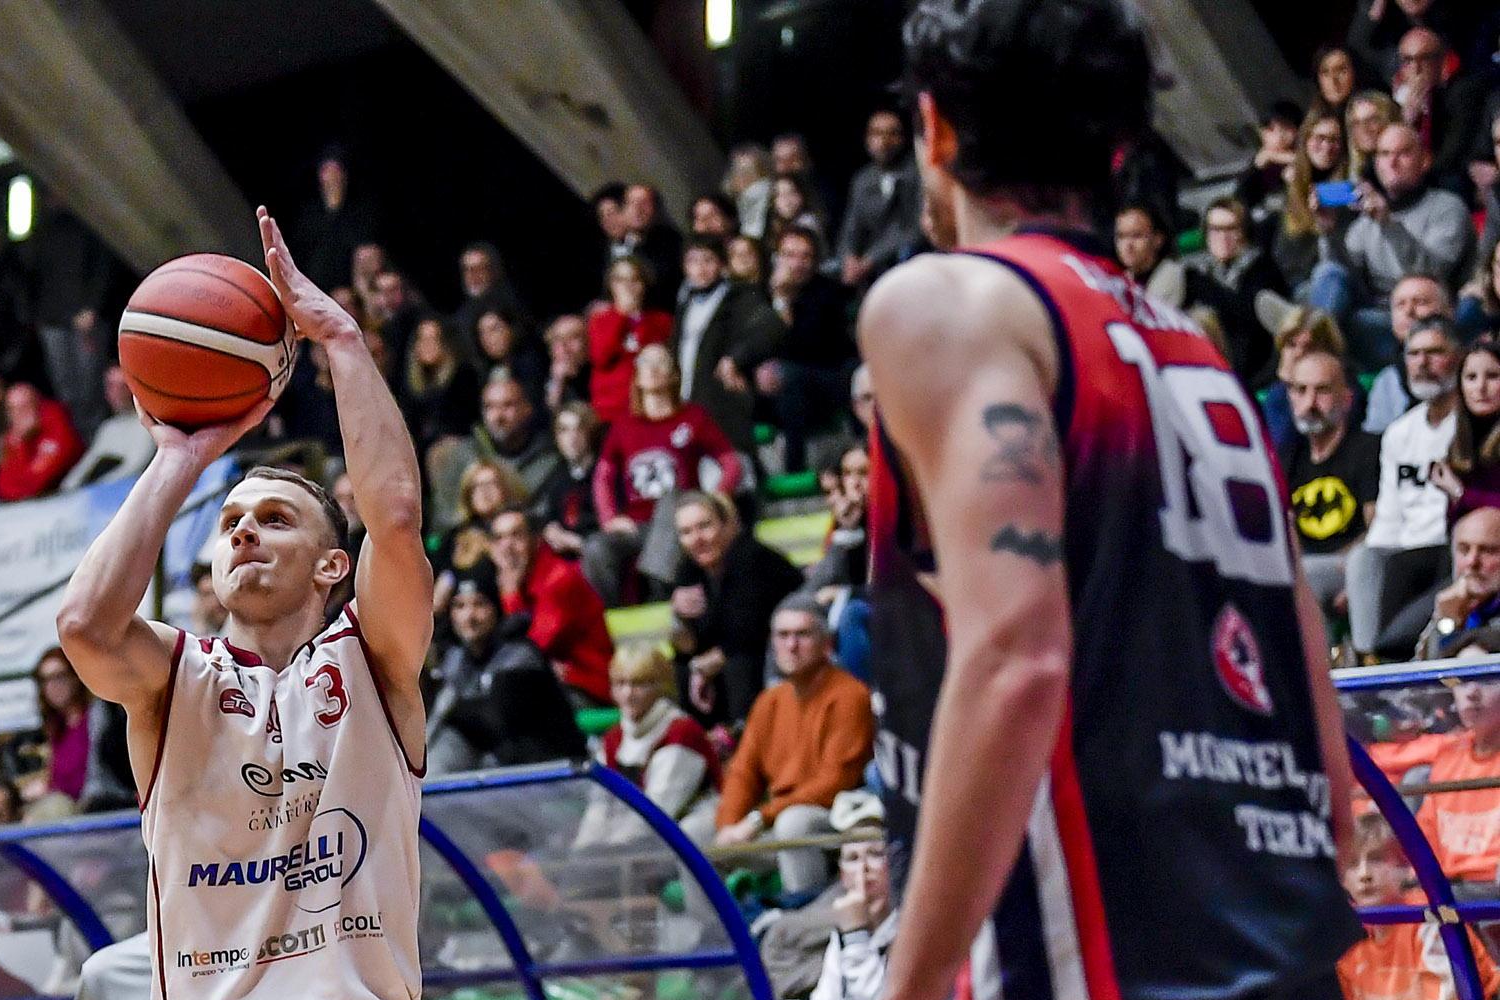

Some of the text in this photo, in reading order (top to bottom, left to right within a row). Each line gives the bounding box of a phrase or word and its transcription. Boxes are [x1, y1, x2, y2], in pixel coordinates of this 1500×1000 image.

[1106, 322, 1296, 588] 18
[304, 661, 351, 729] 3
[188, 832, 344, 888] MAURELLI
